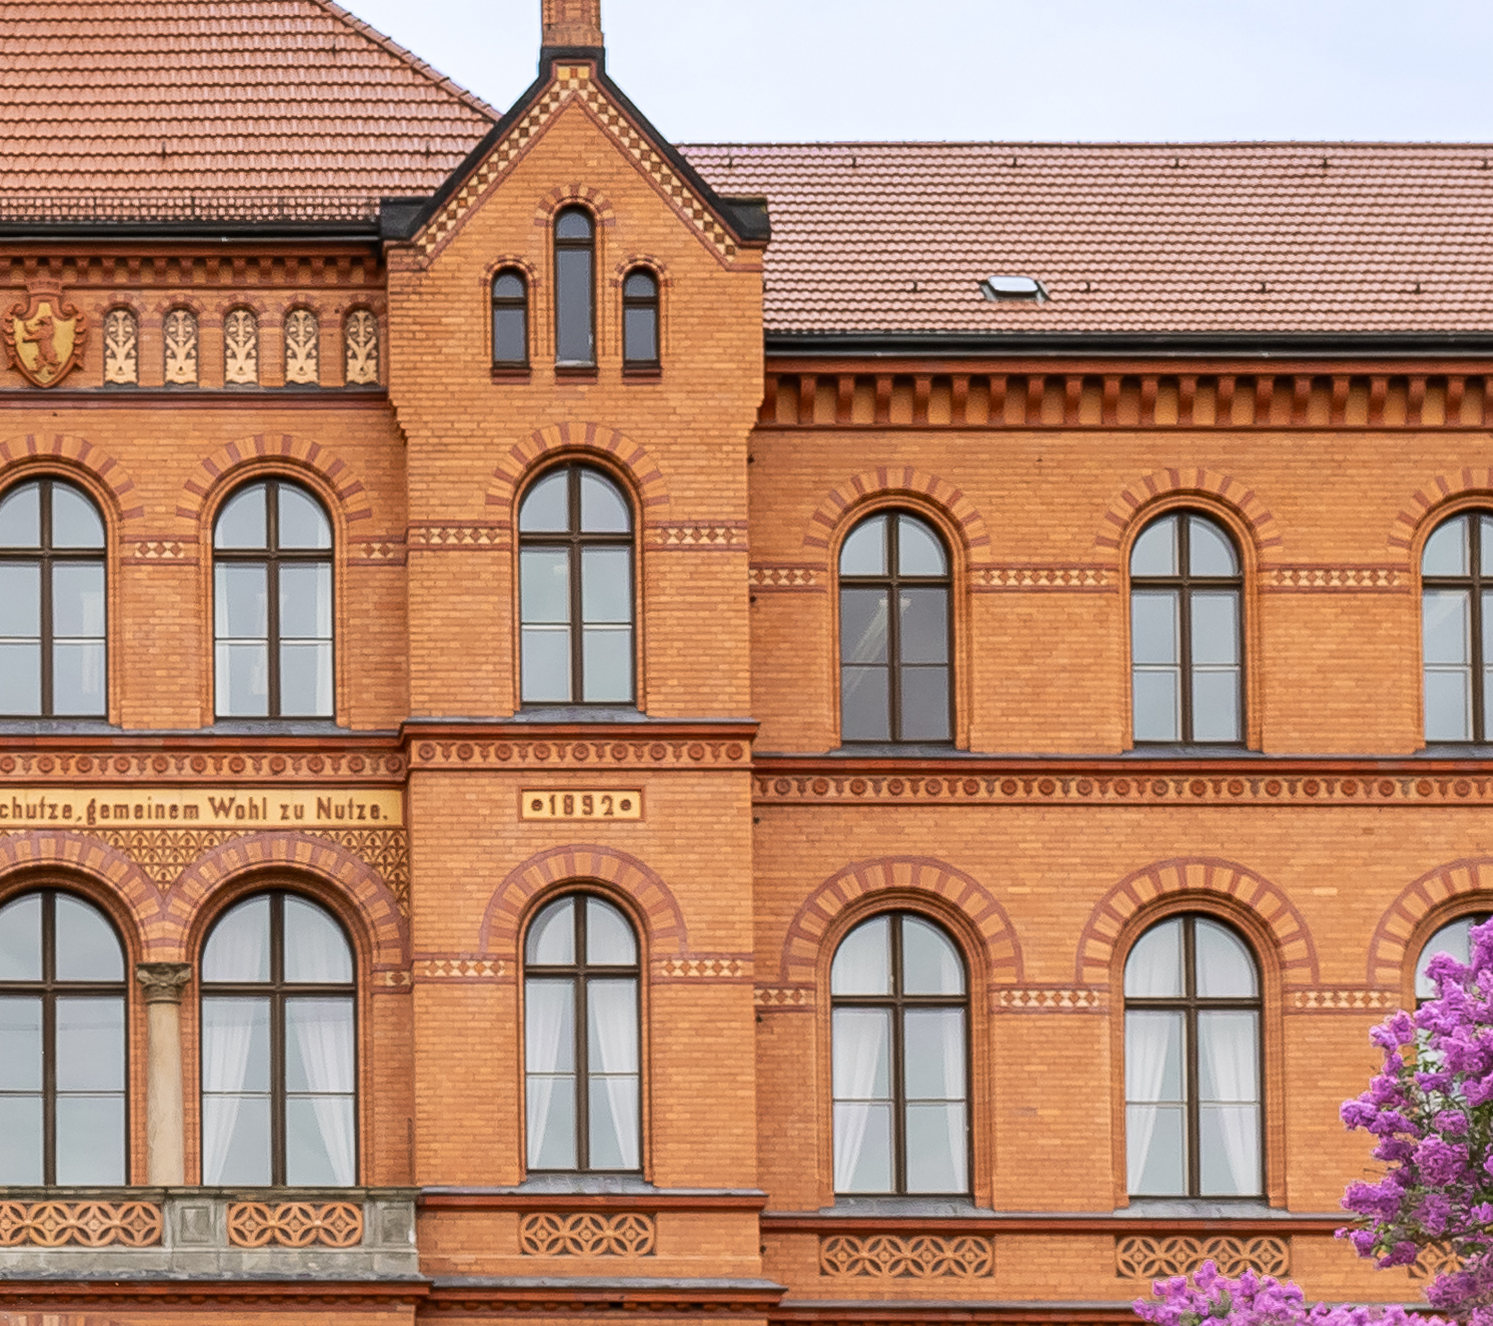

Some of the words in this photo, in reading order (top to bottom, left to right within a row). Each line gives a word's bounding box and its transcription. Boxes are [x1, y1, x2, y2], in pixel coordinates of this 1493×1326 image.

[86, 796, 199, 825] gemeinem
[208, 796, 267, 820] Wohl
[279, 803, 304, 820] zu
[316, 796, 388, 820] Nutze.
[549, 794, 614, 816] 1892
